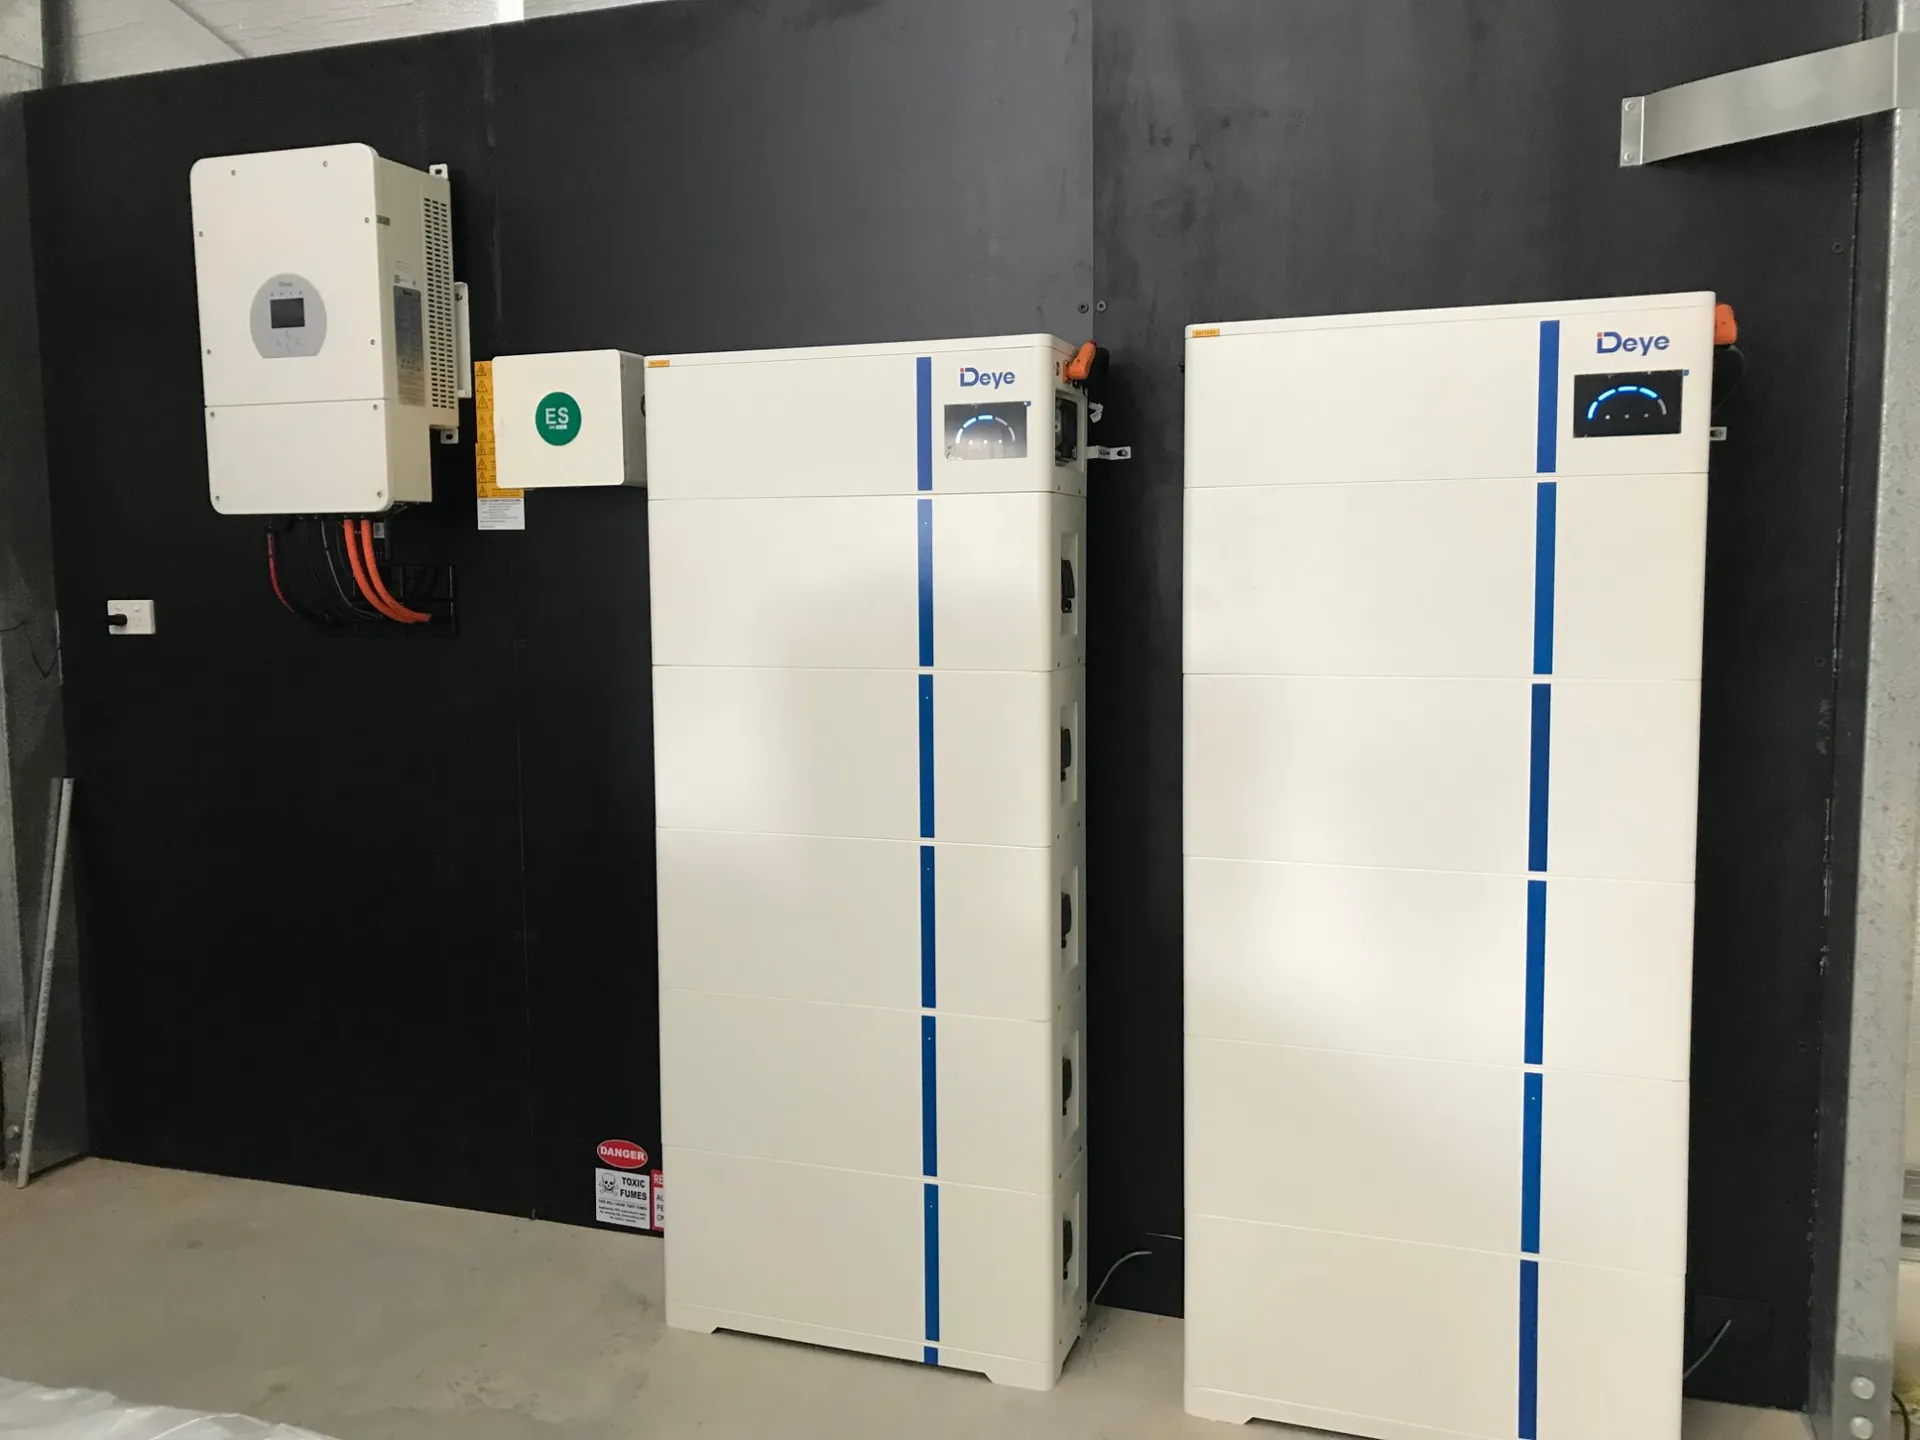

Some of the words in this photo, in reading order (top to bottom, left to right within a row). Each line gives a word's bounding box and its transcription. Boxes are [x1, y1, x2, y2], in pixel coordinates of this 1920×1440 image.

[1596, 331, 1670, 356] Deye
[959, 367, 1015, 389] Deye
[545, 407, 569, 424] ES
[600, 1146, 645, 1161] DANGER
[621, 1176, 646, 1188] TOXIC
[620, 1189, 648, 1201] FUMES
